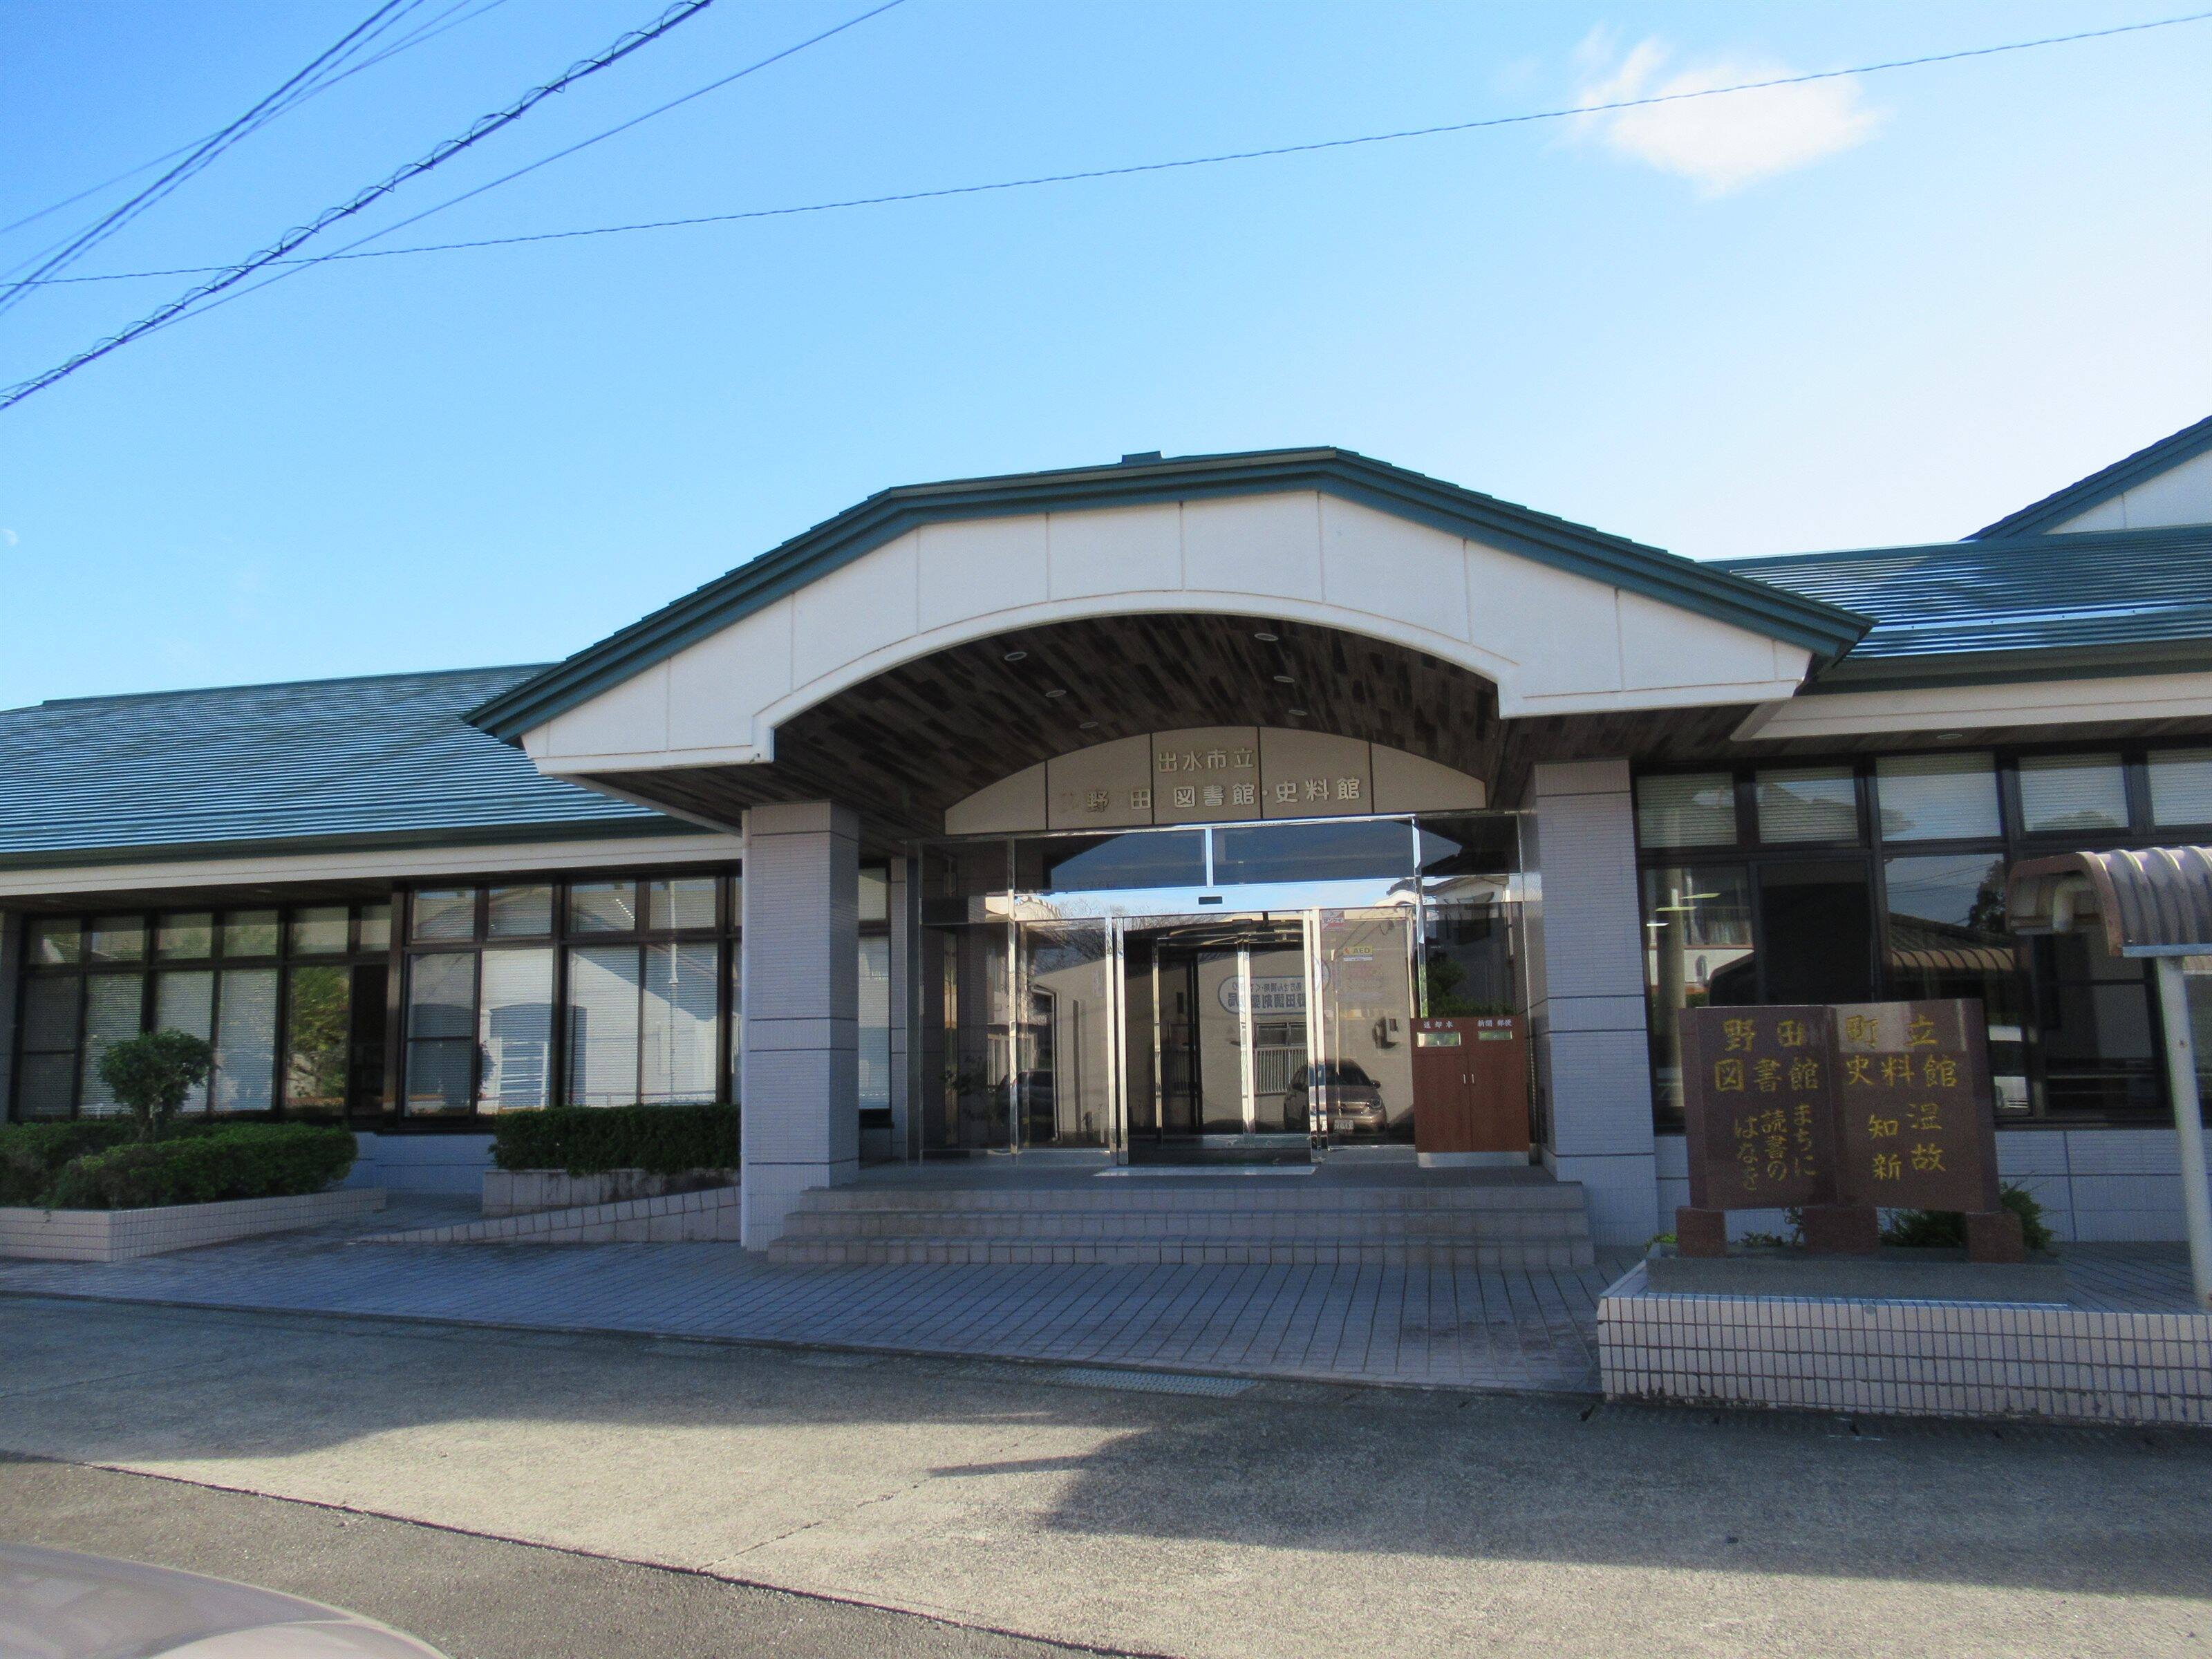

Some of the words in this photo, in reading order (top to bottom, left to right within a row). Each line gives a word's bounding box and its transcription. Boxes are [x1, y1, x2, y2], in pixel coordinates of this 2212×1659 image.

[1158, 748, 1255, 773] 出水市立
[1714, 1057, 1819, 1093] 図書館
[1846, 1054, 1958, 1089] 史料館
[1760, 1109, 1788, 1181] 読書の
